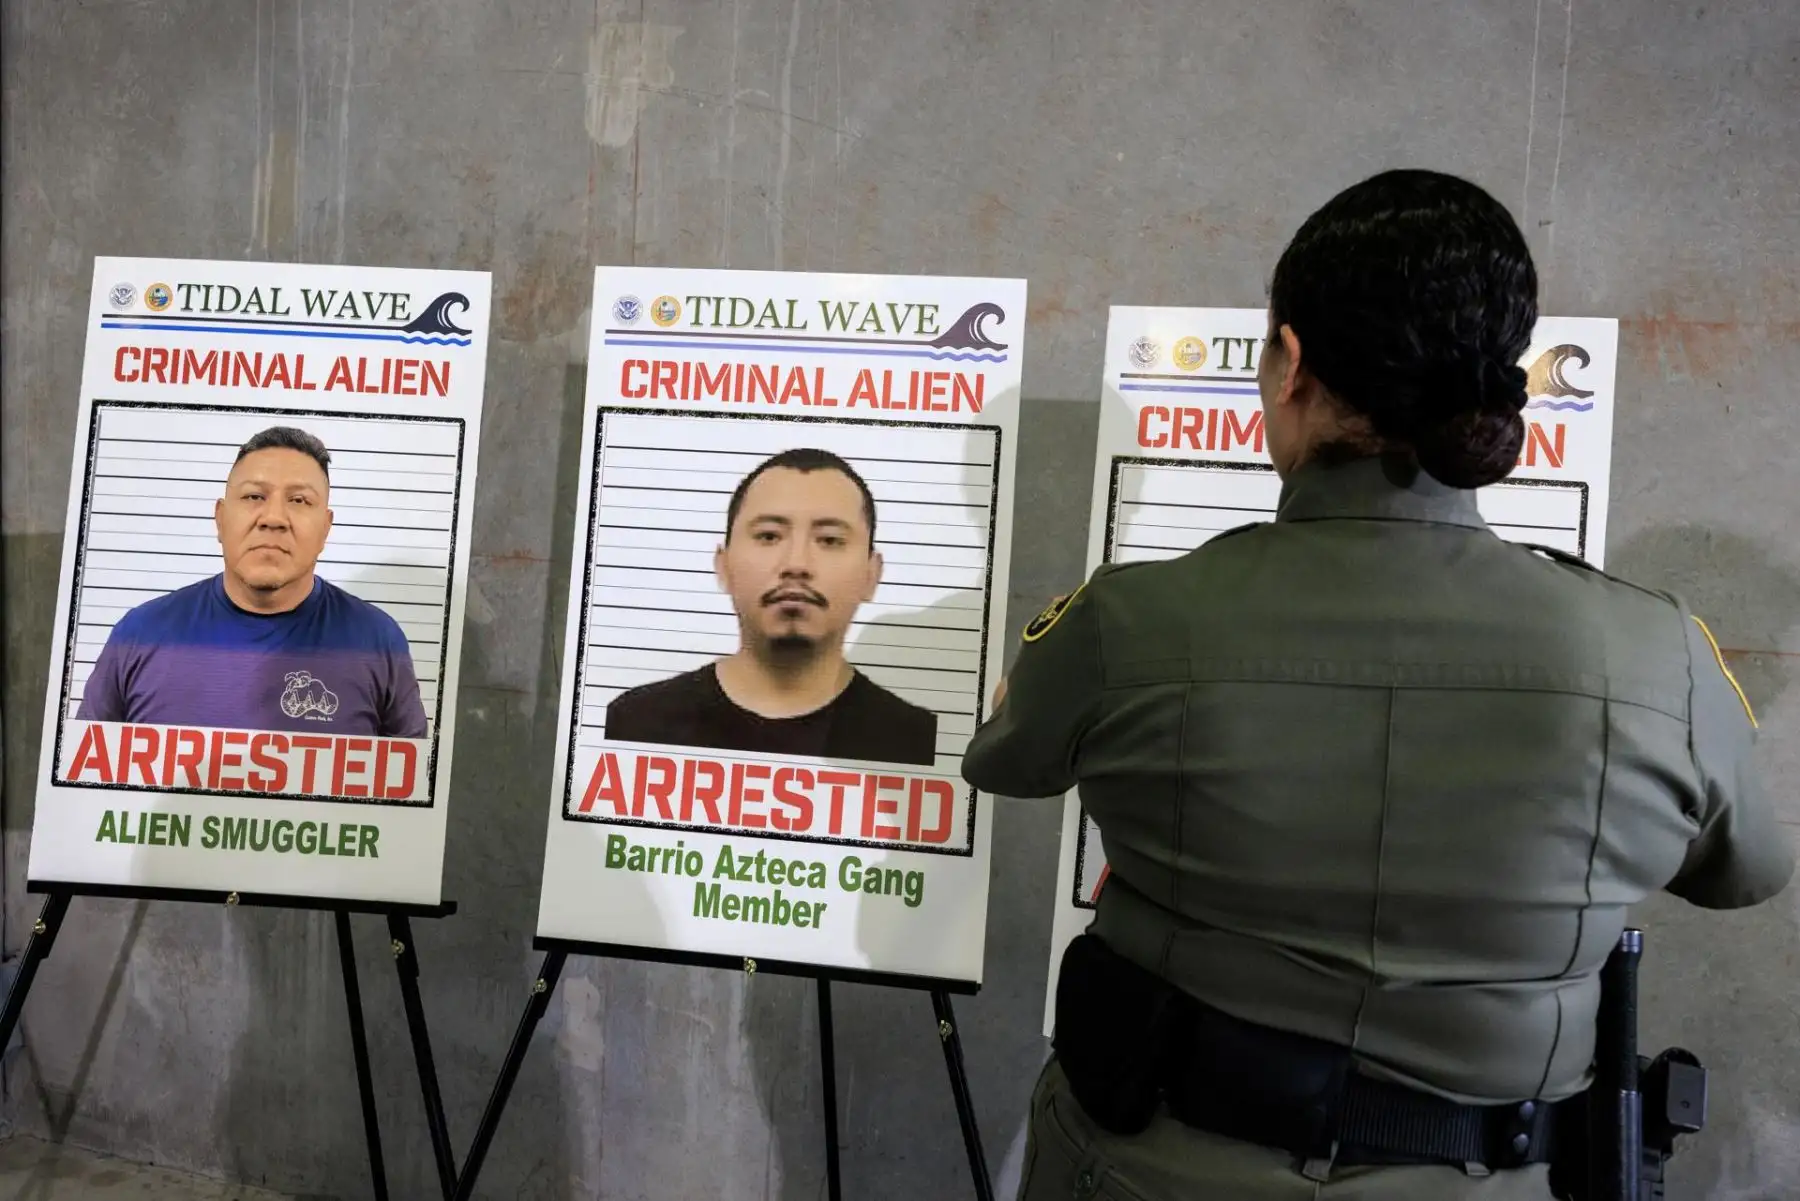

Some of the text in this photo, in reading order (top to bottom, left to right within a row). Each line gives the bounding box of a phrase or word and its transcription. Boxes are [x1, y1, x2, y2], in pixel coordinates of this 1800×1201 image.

[178, 283, 290, 316] TIDAL
[301, 289, 411, 322] WAVE
[686, 295, 808, 332] TIDAL
[819, 300, 940, 335] WAVE
[114, 346, 450, 397] CRIMINAL ALIEN
[620, 359, 985, 413] CRIMINAL ALIEN
[1137, 406, 1265, 453] CRIM
[66, 723, 417, 800] ARRESTED
[578, 752, 954, 844] ARRESTED
[96, 810, 380, 858] ALIEN SMUGGLER
[604, 834, 925, 908] Barrio Azteca Gang
[692, 881, 828, 929] Member
